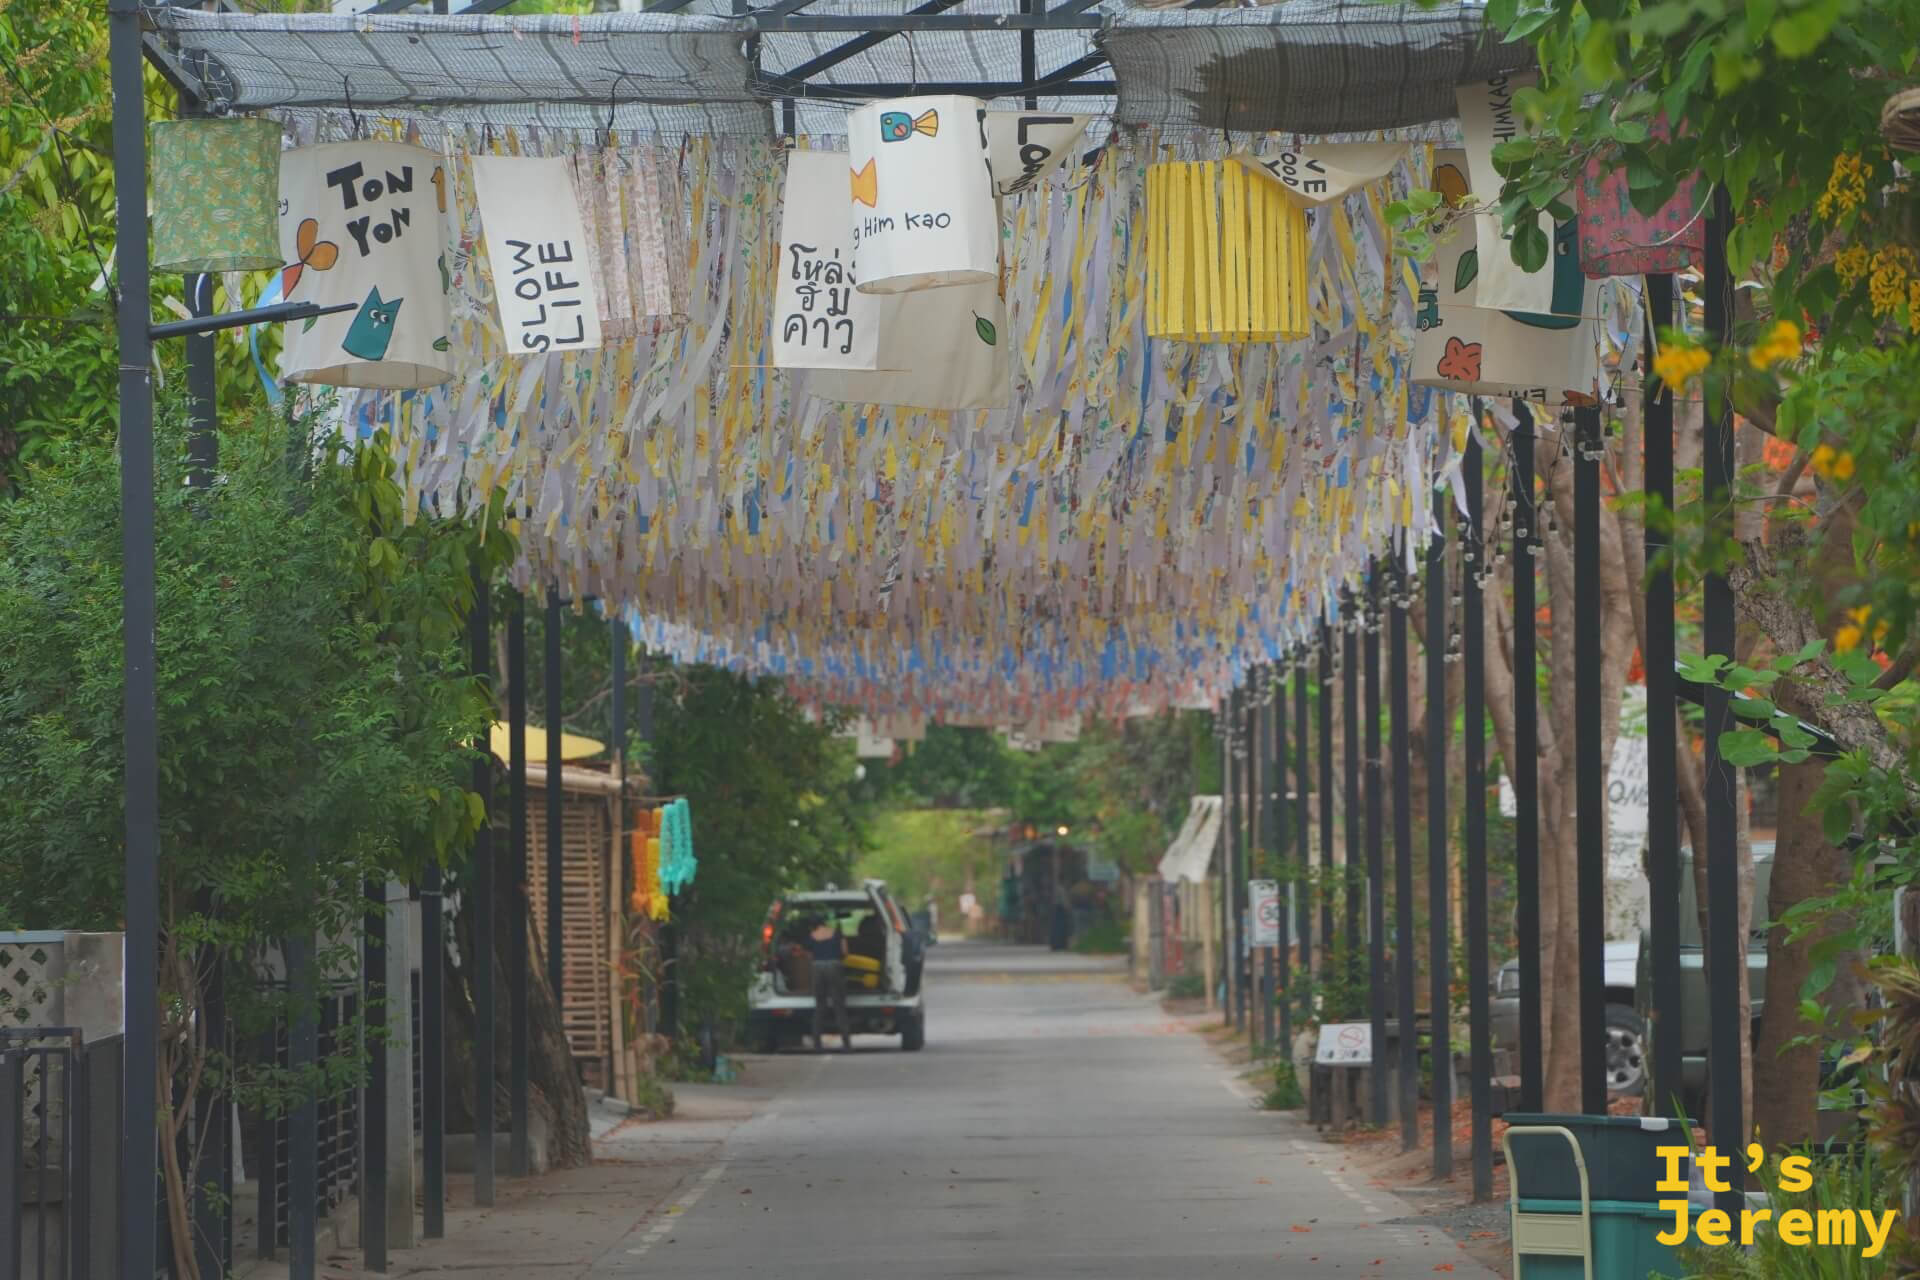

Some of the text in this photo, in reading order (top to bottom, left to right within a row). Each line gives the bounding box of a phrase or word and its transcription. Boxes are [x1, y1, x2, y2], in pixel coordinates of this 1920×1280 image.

[864, 215, 895, 238] Him
[505, 240, 551, 354] SLOW
[538, 240, 585, 344] LIFE
[783, 313, 854, 355] คาว
